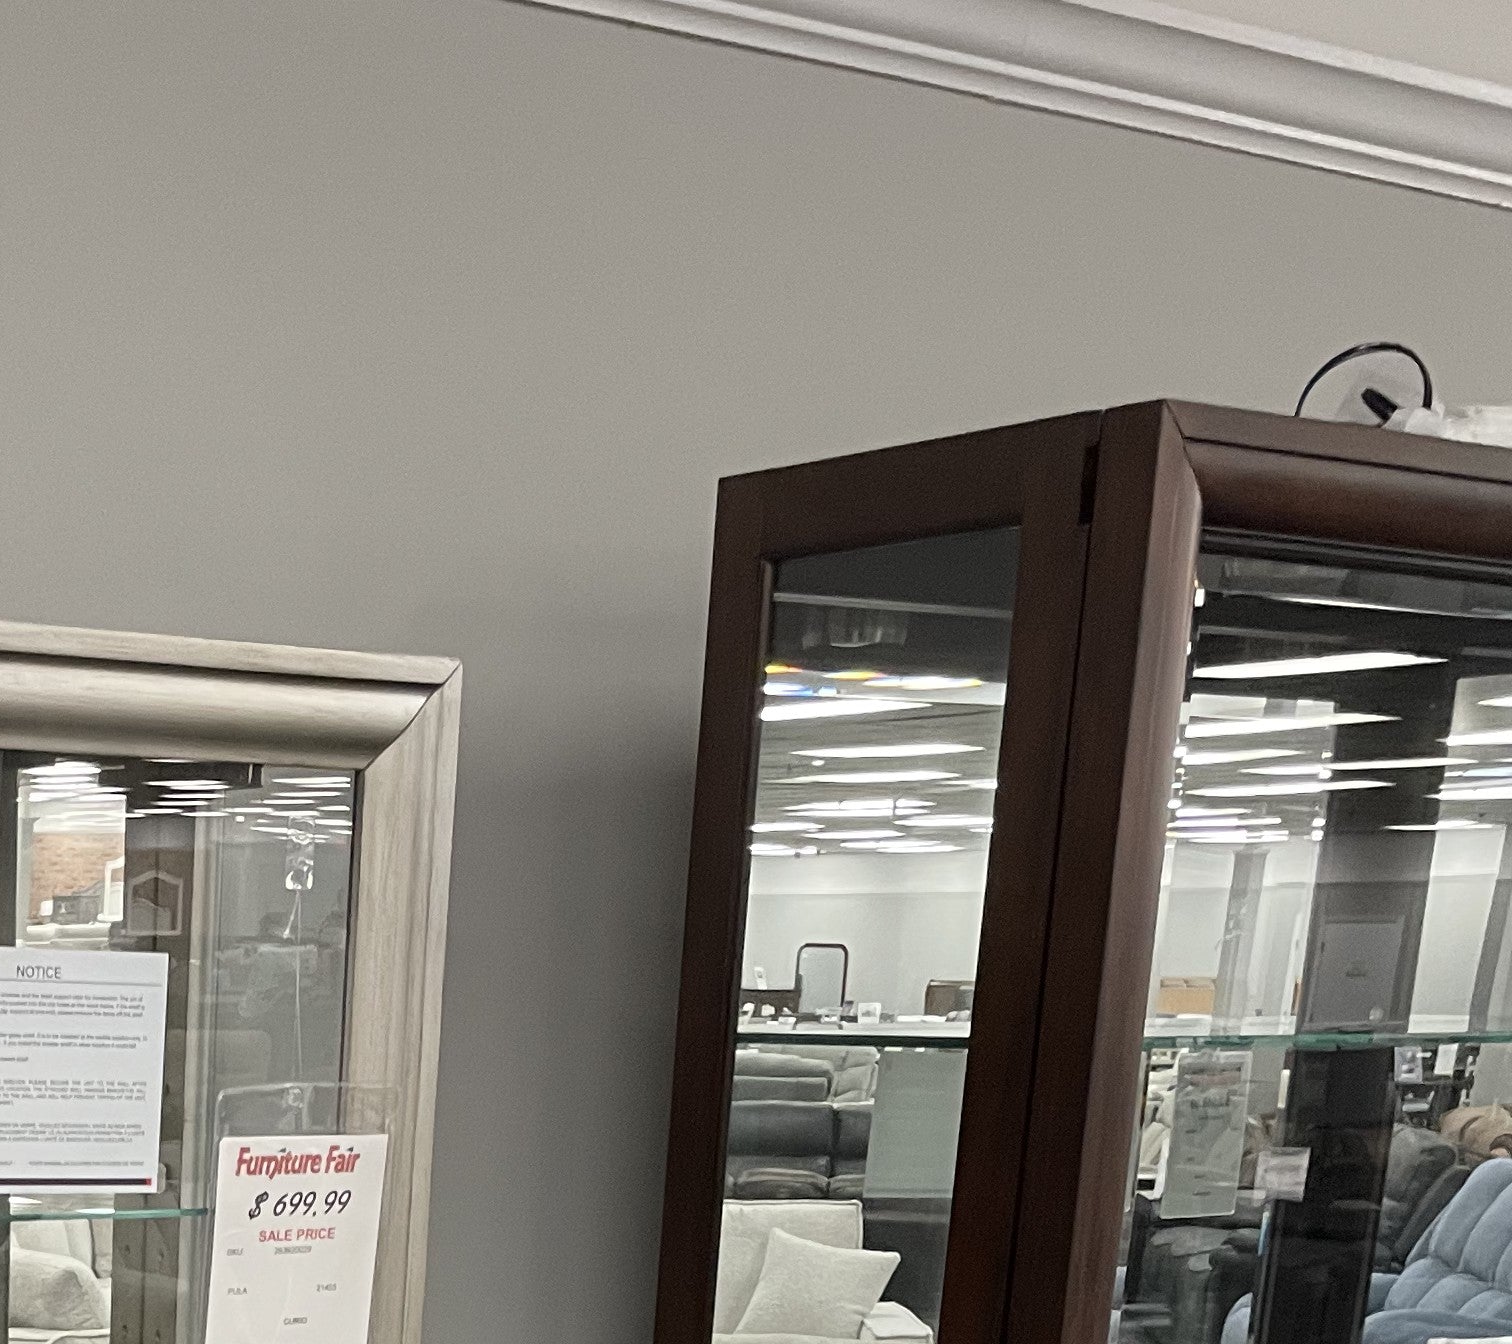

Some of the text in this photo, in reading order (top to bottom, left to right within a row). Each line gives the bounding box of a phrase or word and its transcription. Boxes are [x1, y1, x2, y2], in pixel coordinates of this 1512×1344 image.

[16, 965, 62, 980] NOTICE
[235, 1145, 361, 1179] Furniture Fair
[248, 1189, 352, 1220] $ 699.99
[259, 1226, 337, 1242] SALE PRICE
